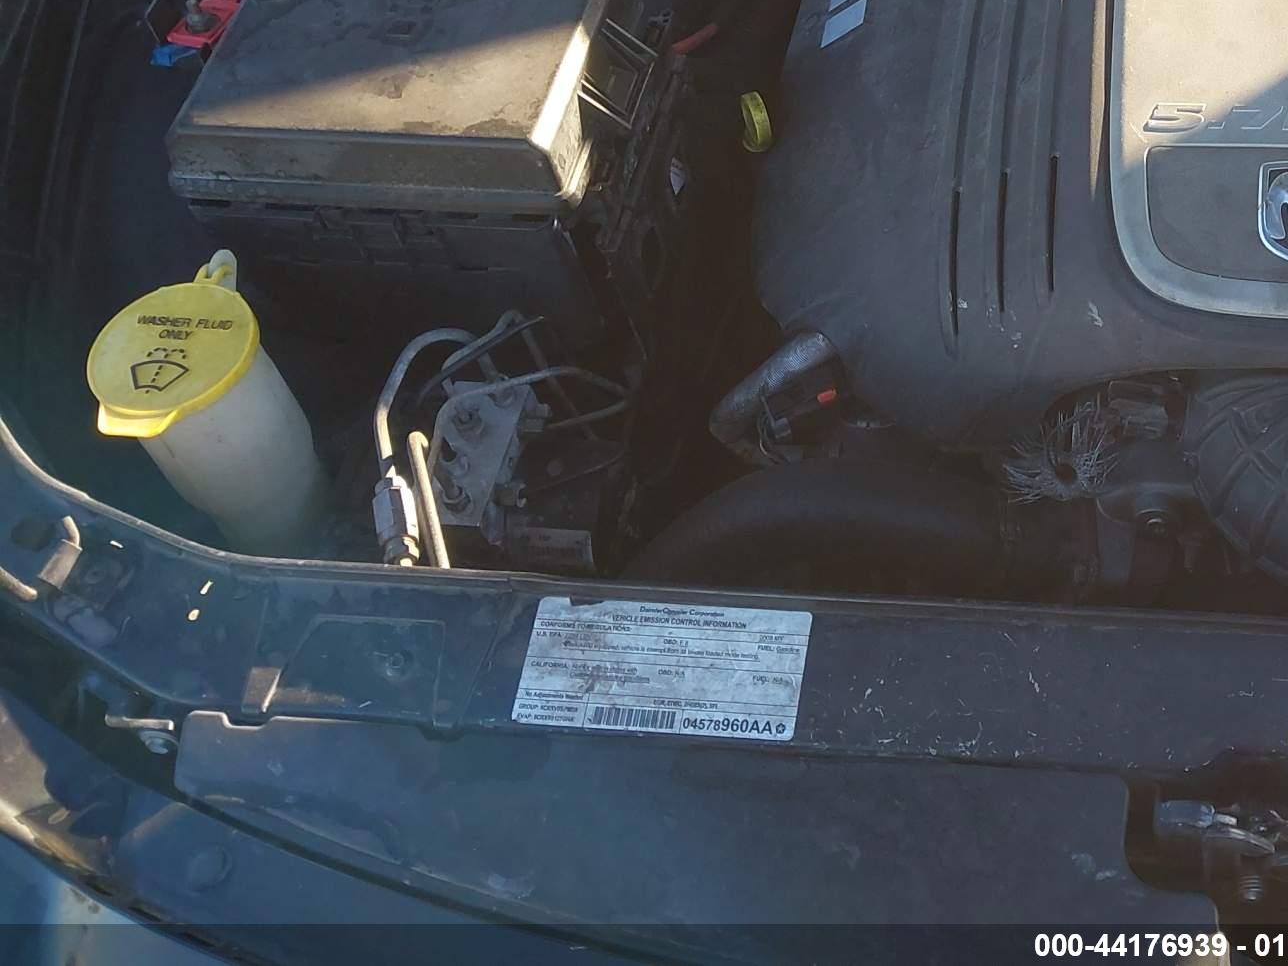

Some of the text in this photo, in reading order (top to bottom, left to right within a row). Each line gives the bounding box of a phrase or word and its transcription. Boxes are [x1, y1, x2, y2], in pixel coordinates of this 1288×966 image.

[137, 315, 233, 331] WASHER FLUID
[158, 329, 193, 340] ONLY
[611, 614, 746, 629] VEHICLE EMISSION CONTROL INFORMATION
[682, 717, 773, 735] 04578960AA
